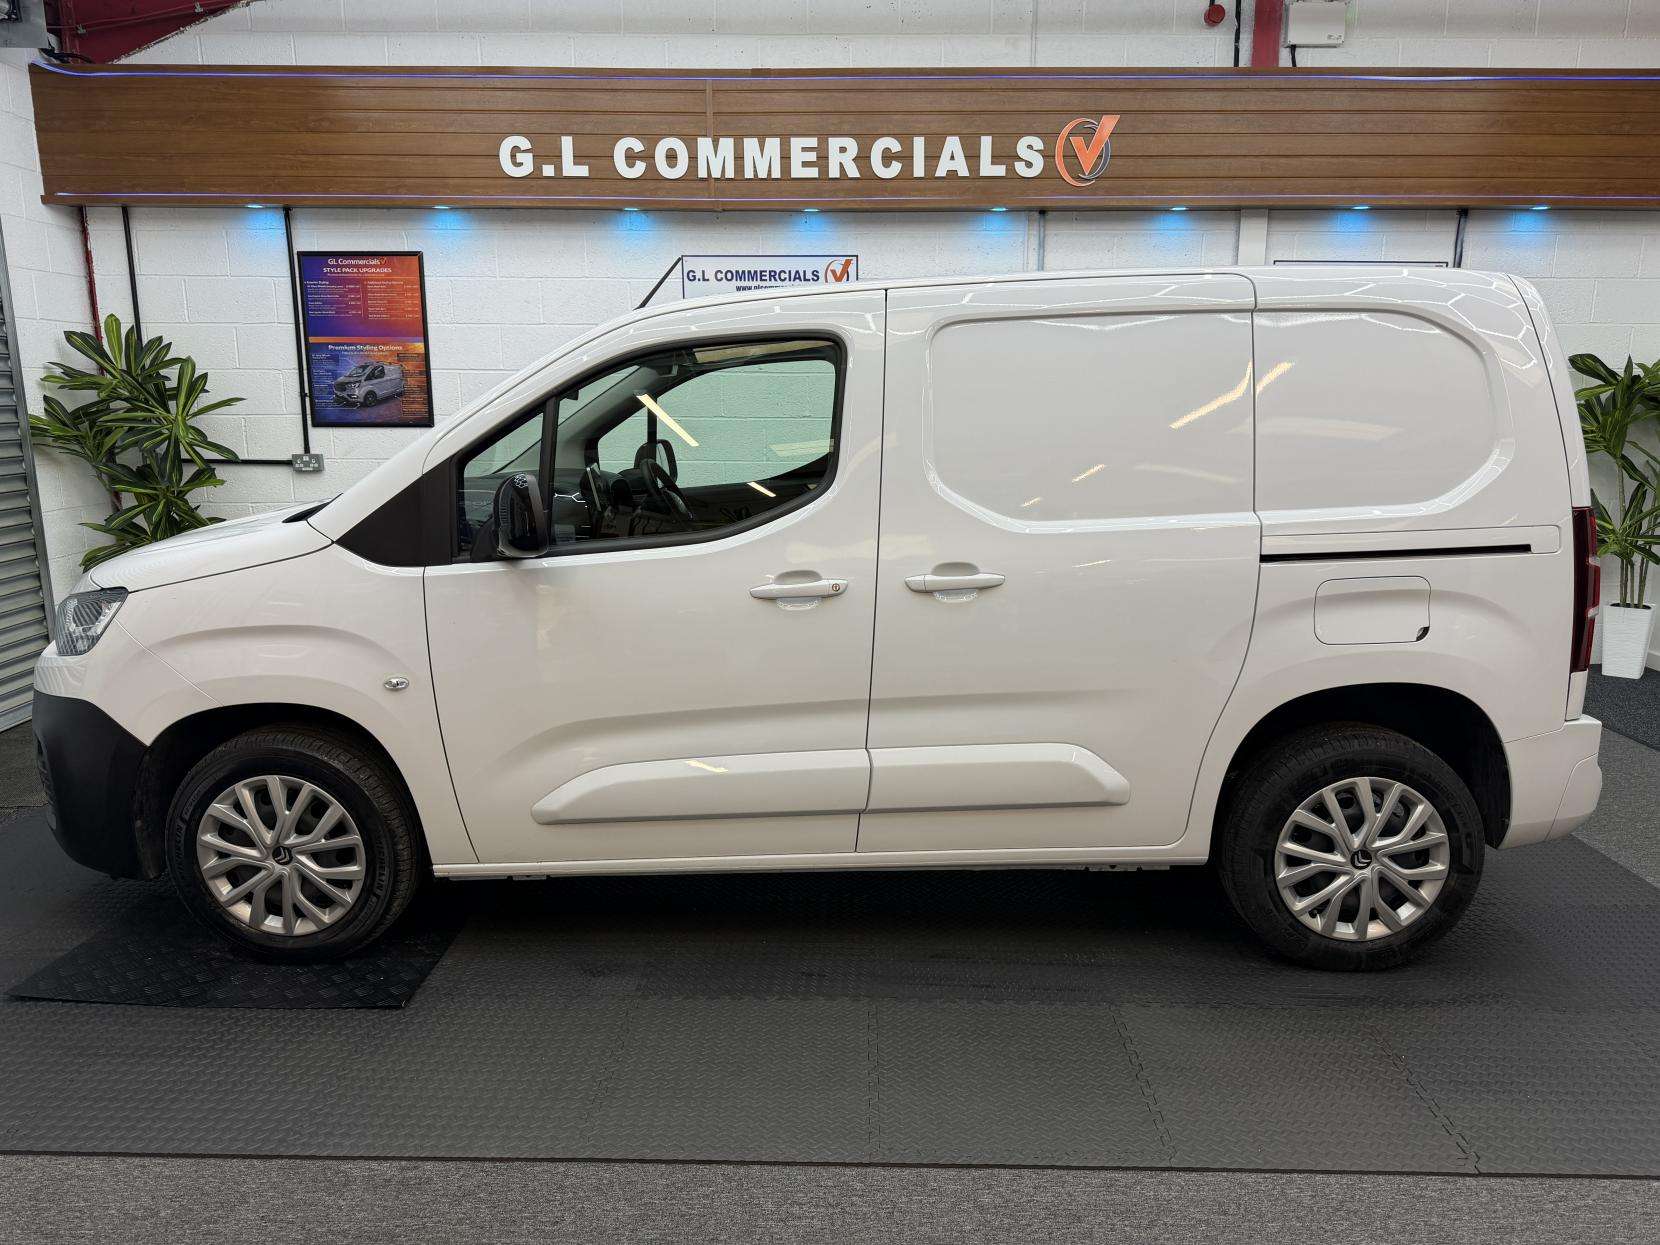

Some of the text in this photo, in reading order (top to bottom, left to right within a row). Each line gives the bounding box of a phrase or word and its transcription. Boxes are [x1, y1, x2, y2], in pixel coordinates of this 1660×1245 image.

[498, 135, 1046, 180] G.L COMMERCIALS
[686, 269, 820, 282] G.L COMMERCIALS
